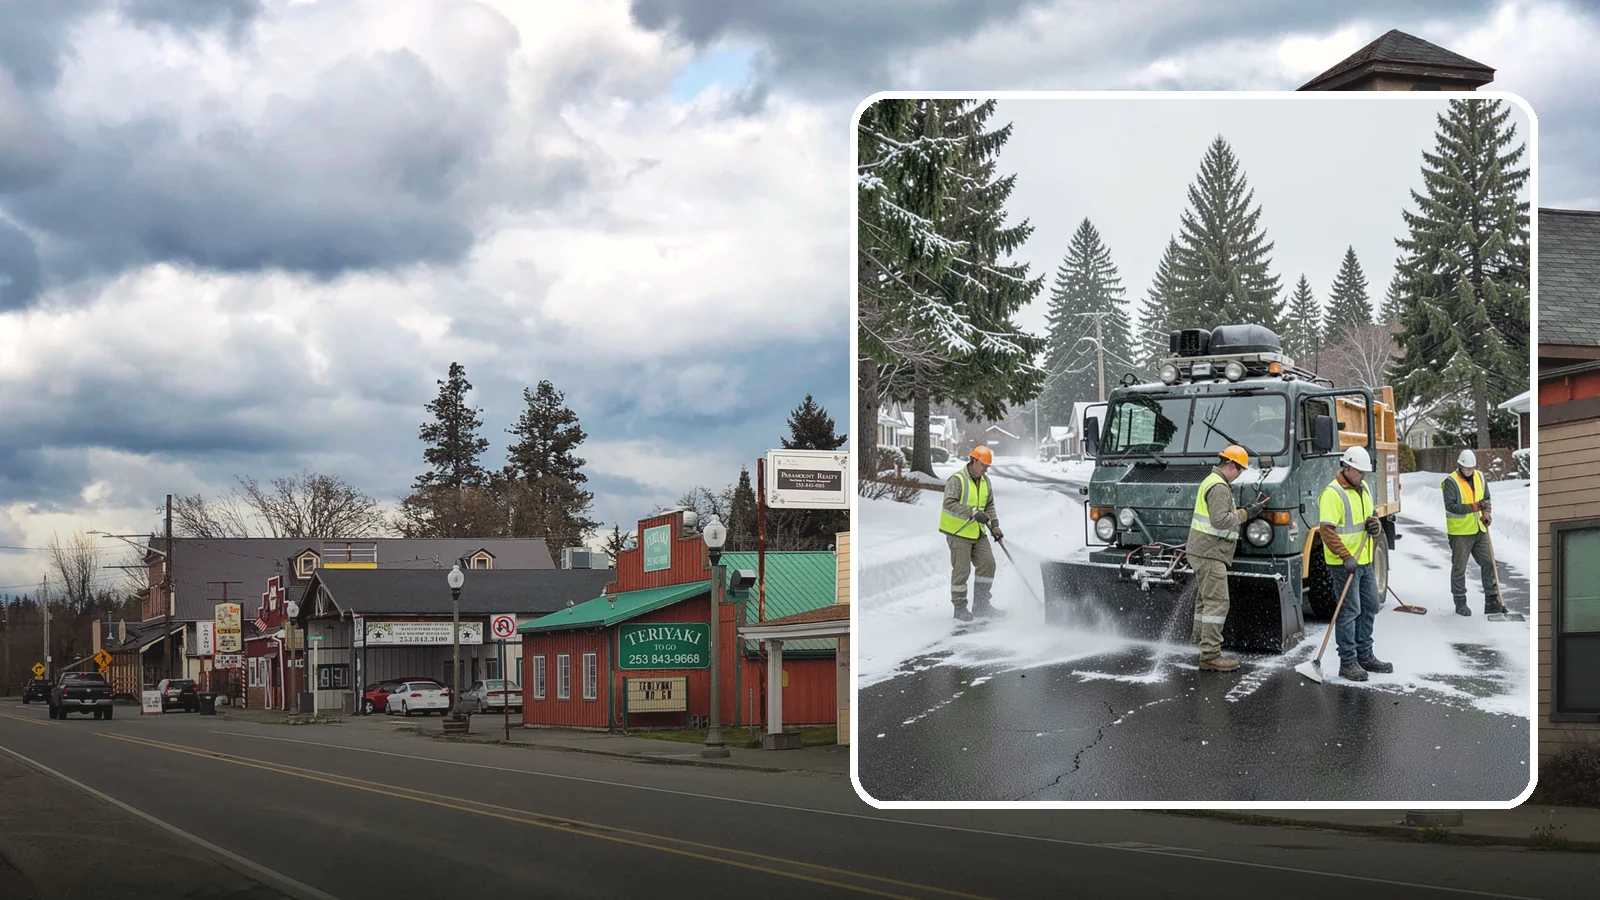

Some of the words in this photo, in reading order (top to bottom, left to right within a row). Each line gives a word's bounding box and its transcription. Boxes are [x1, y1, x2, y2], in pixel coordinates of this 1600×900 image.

[625, 627, 701, 646] TERIYAKI
[628, 654, 648, 664] 253
[651, 654, 700, 664] 843-9668
